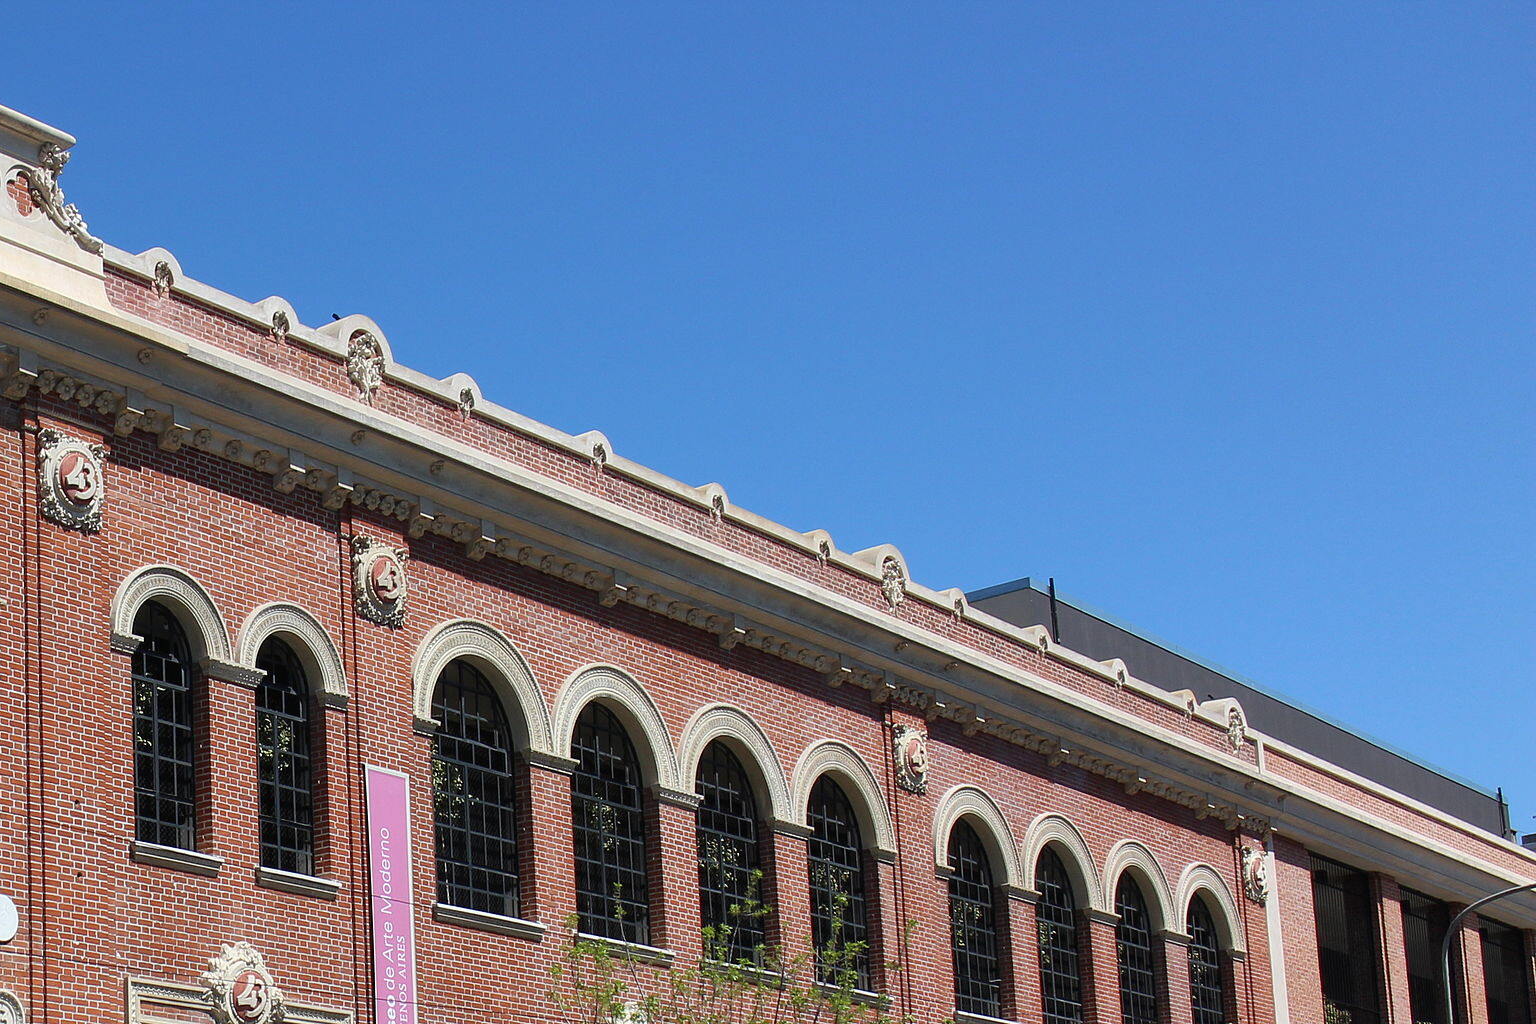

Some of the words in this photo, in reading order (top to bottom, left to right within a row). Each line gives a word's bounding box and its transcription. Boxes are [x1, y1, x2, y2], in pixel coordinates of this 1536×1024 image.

[65, 457, 97, 500] 43
[379, 827, 392, 915] Moderno
[382, 921, 394, 963] Arte
[397, 935, 406, 979] AIRES
[237, 974, 267, 1018] 43
[383, 966, 395, 990] de
